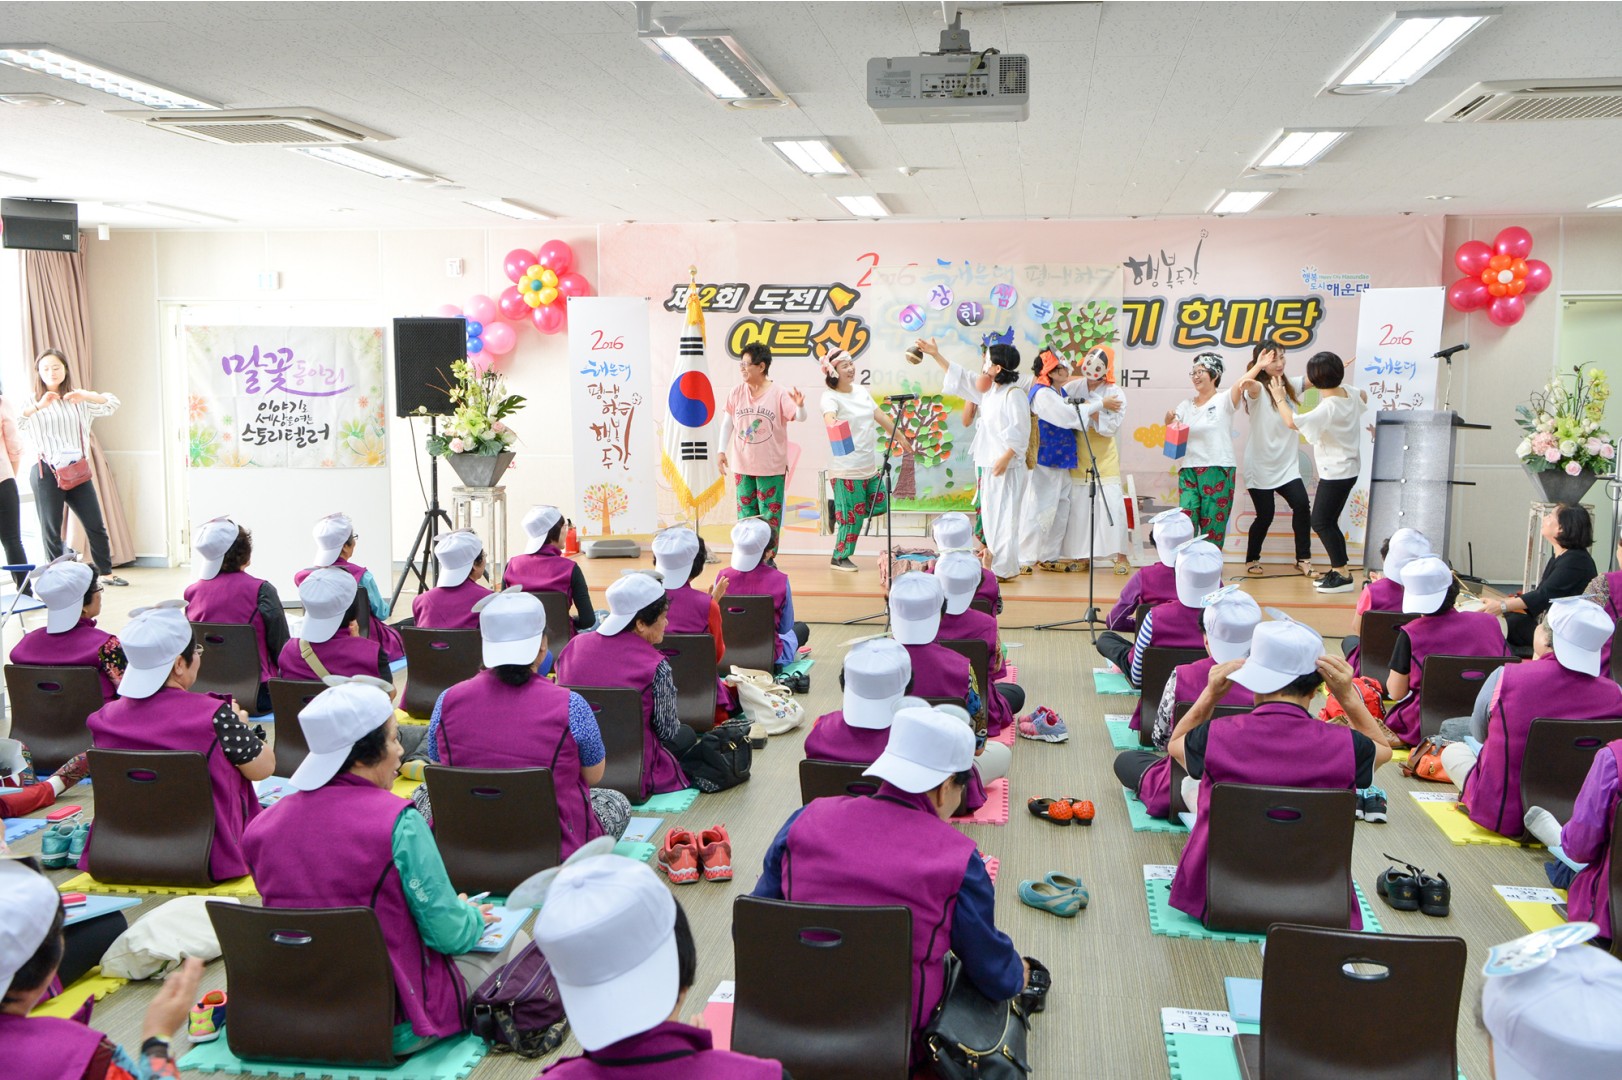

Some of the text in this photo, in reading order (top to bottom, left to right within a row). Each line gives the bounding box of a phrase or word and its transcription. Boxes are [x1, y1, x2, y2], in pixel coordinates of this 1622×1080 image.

[752, 287, 829, 311] 도전!
[1326, 283, 1370, 297] 해운대
[1175, 301, 1320, 345] 한마당
[1378, 323, 1416, 346] 2016
[589, 329, 625, 351] 2016
[292, 360, 345, 386] 동아리
[580, 360, 632, 382] 해운대
[1364, 356, 1418, 381] 해운대
[257, 400, 309, 413] 이야기로
[255, 414, 294, 427] 세상을
[241, 423, 330, 449] 스토리텔러
